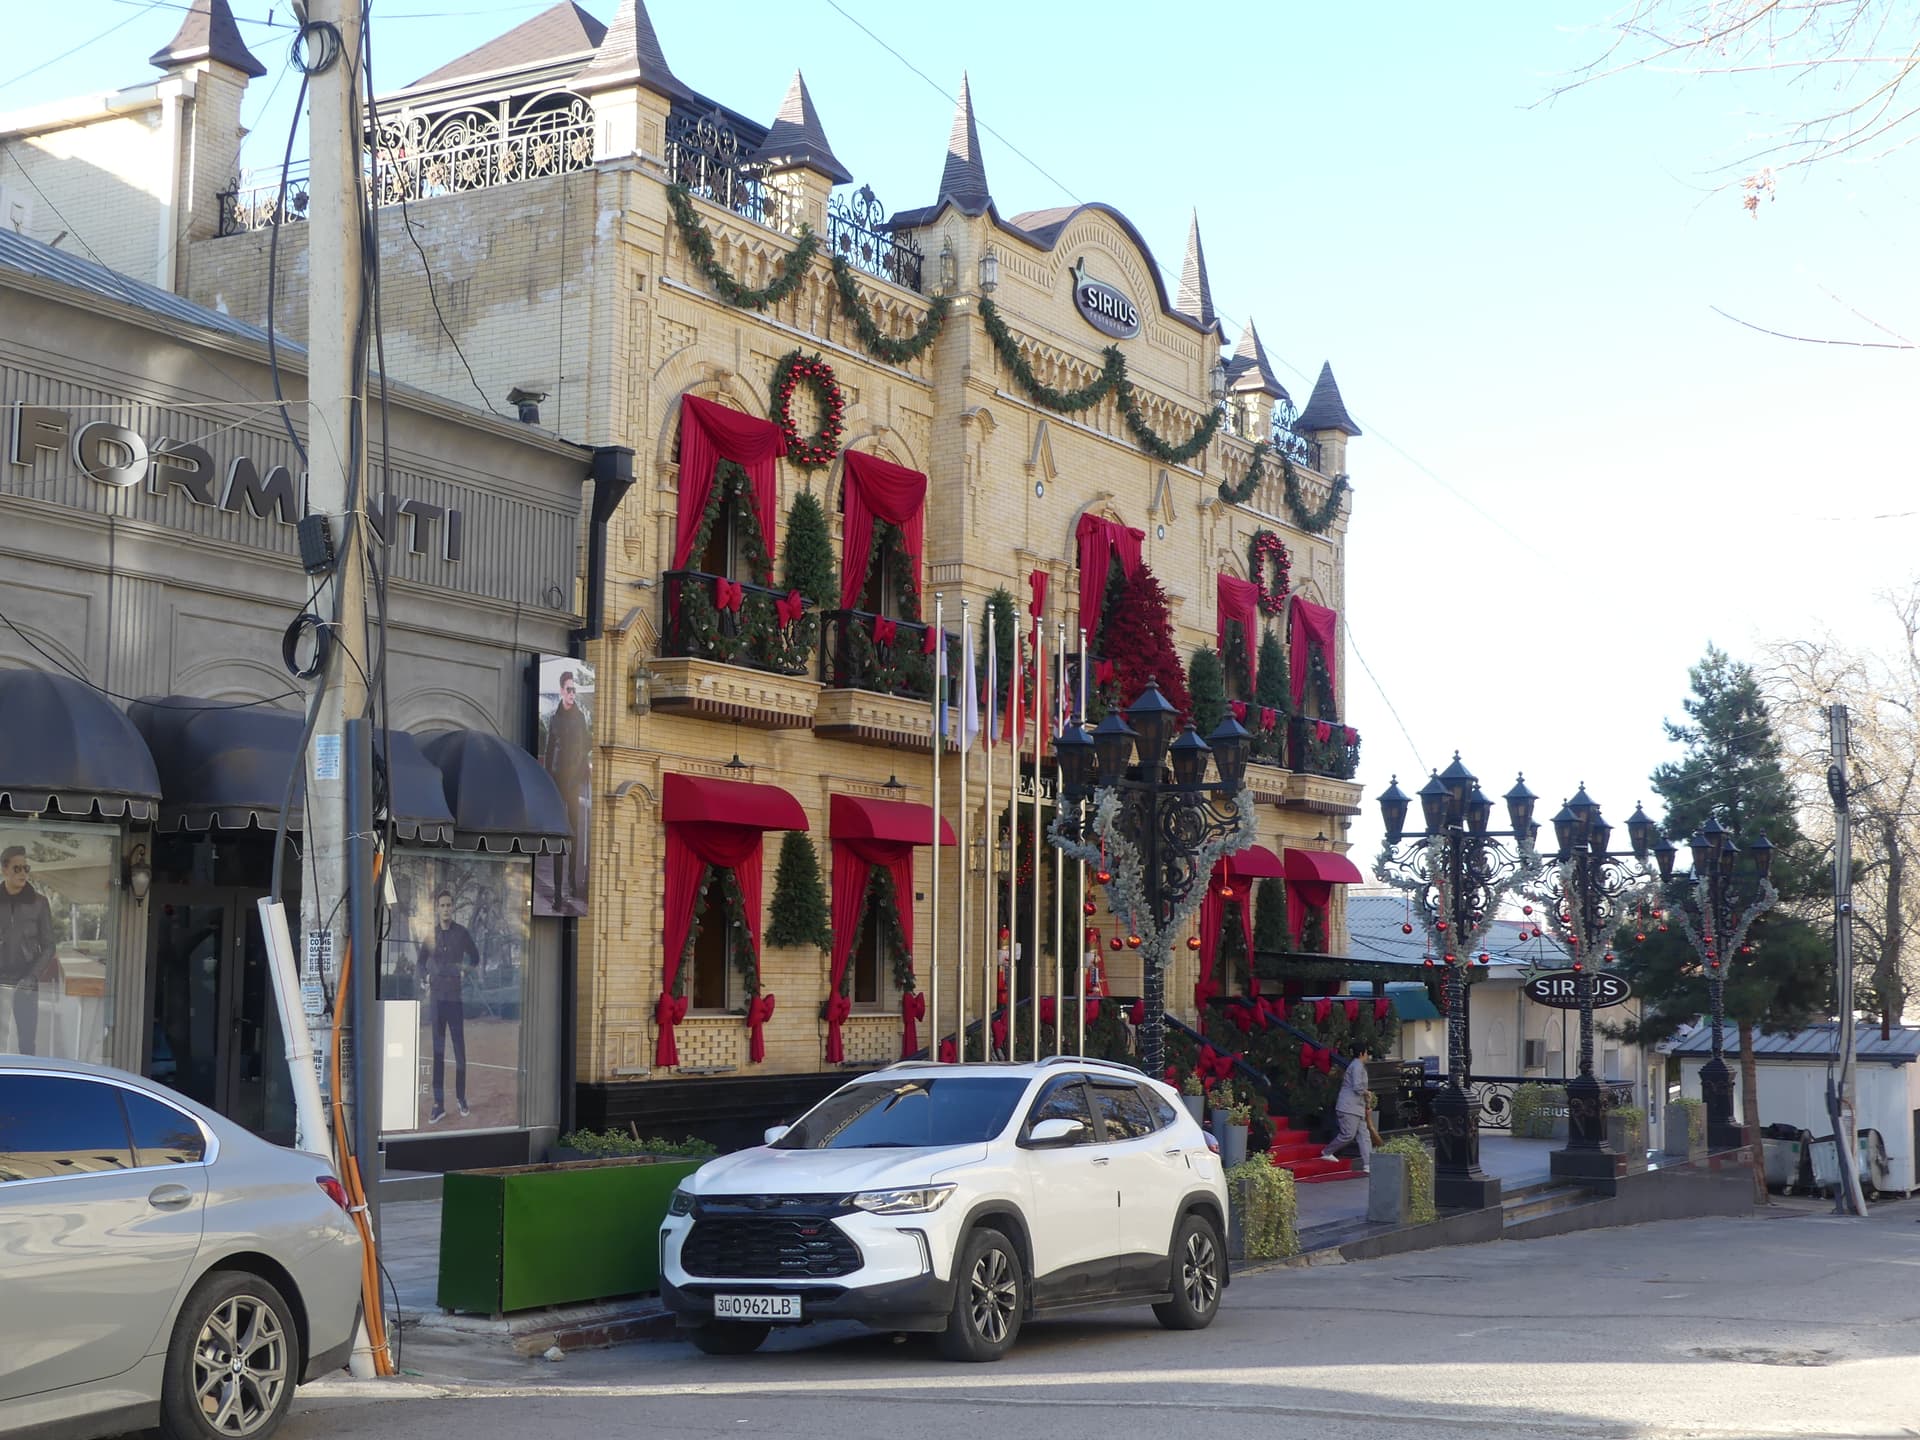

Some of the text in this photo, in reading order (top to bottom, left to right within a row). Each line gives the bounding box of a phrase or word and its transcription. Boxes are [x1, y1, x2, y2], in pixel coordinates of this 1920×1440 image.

[1087, 287, 1138, 327] SIRIUS
[10, 400, 462, 563] FORMNTI
[1018, 774, 1054, 799] EAST
[1535, 979, 1618, 996] SIRUS
